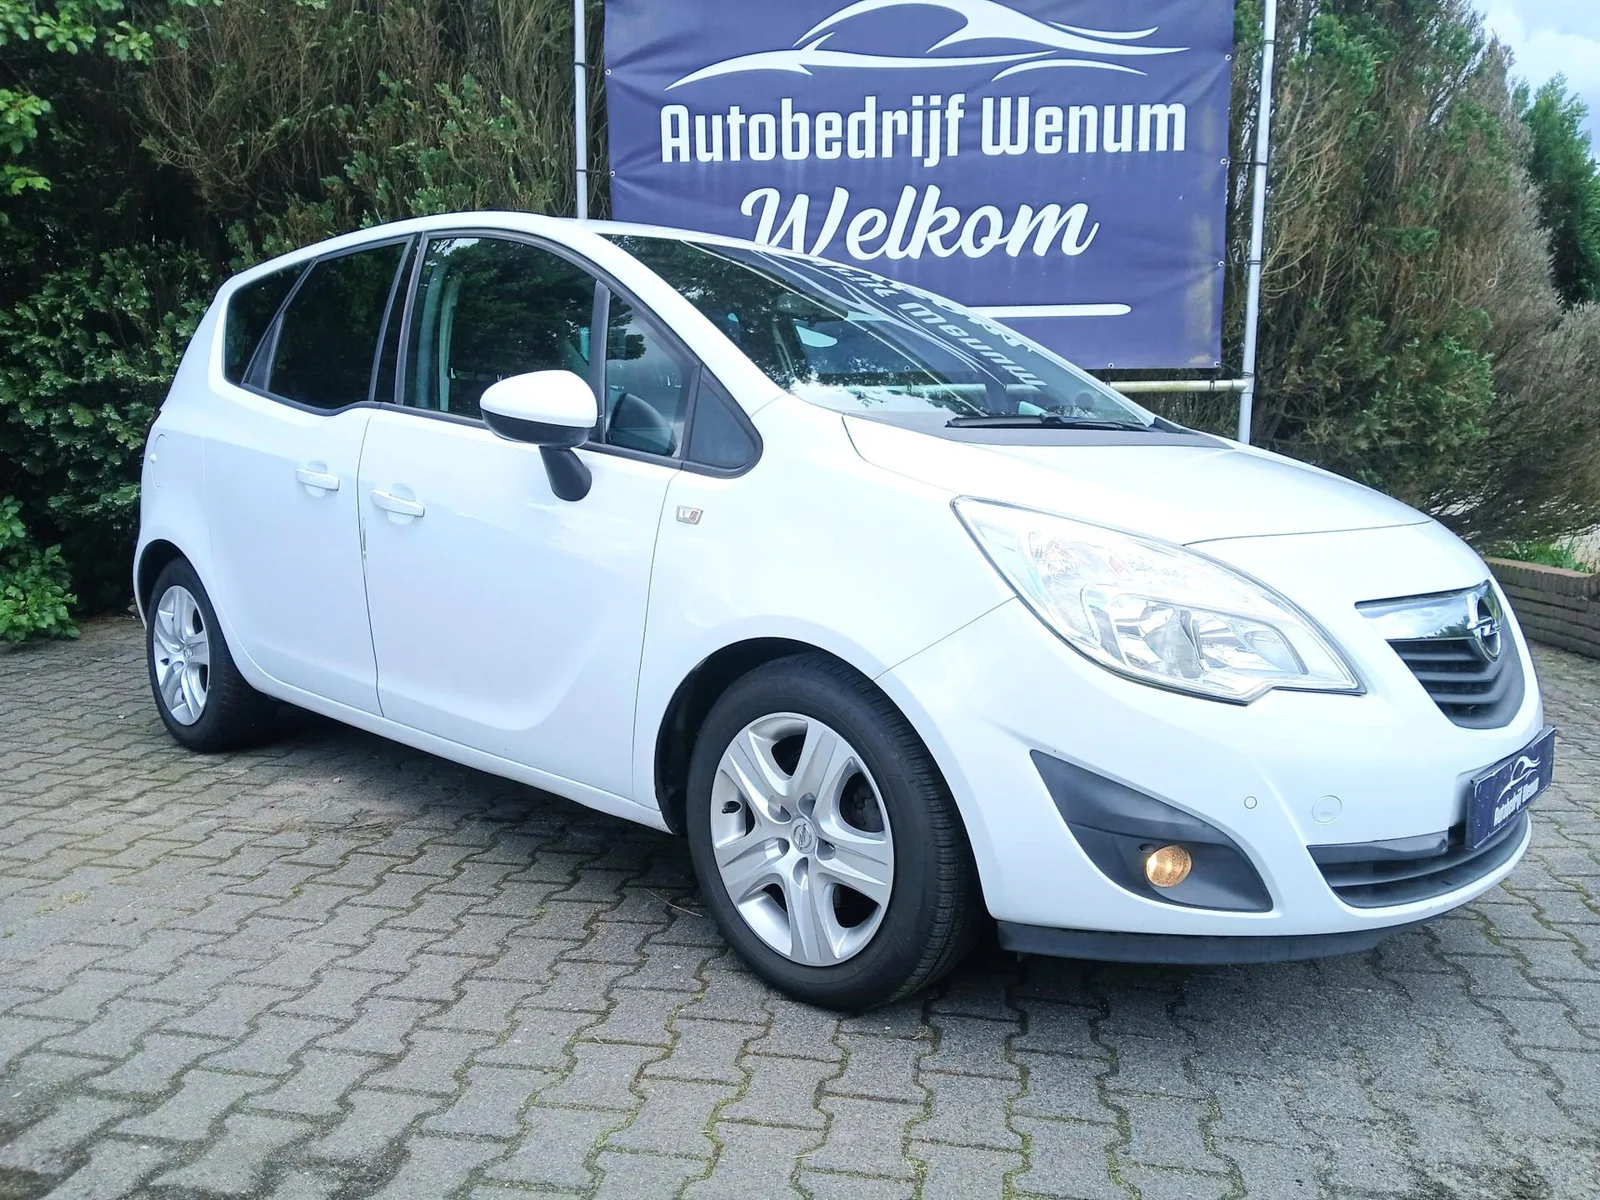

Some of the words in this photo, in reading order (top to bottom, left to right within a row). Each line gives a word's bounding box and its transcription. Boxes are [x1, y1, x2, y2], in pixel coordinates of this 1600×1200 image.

[660, 93, 965, 168] Autobedrijf
[981, 96, 1187, 156] Wenum
[740, 184, 1100, 261] Welkom
